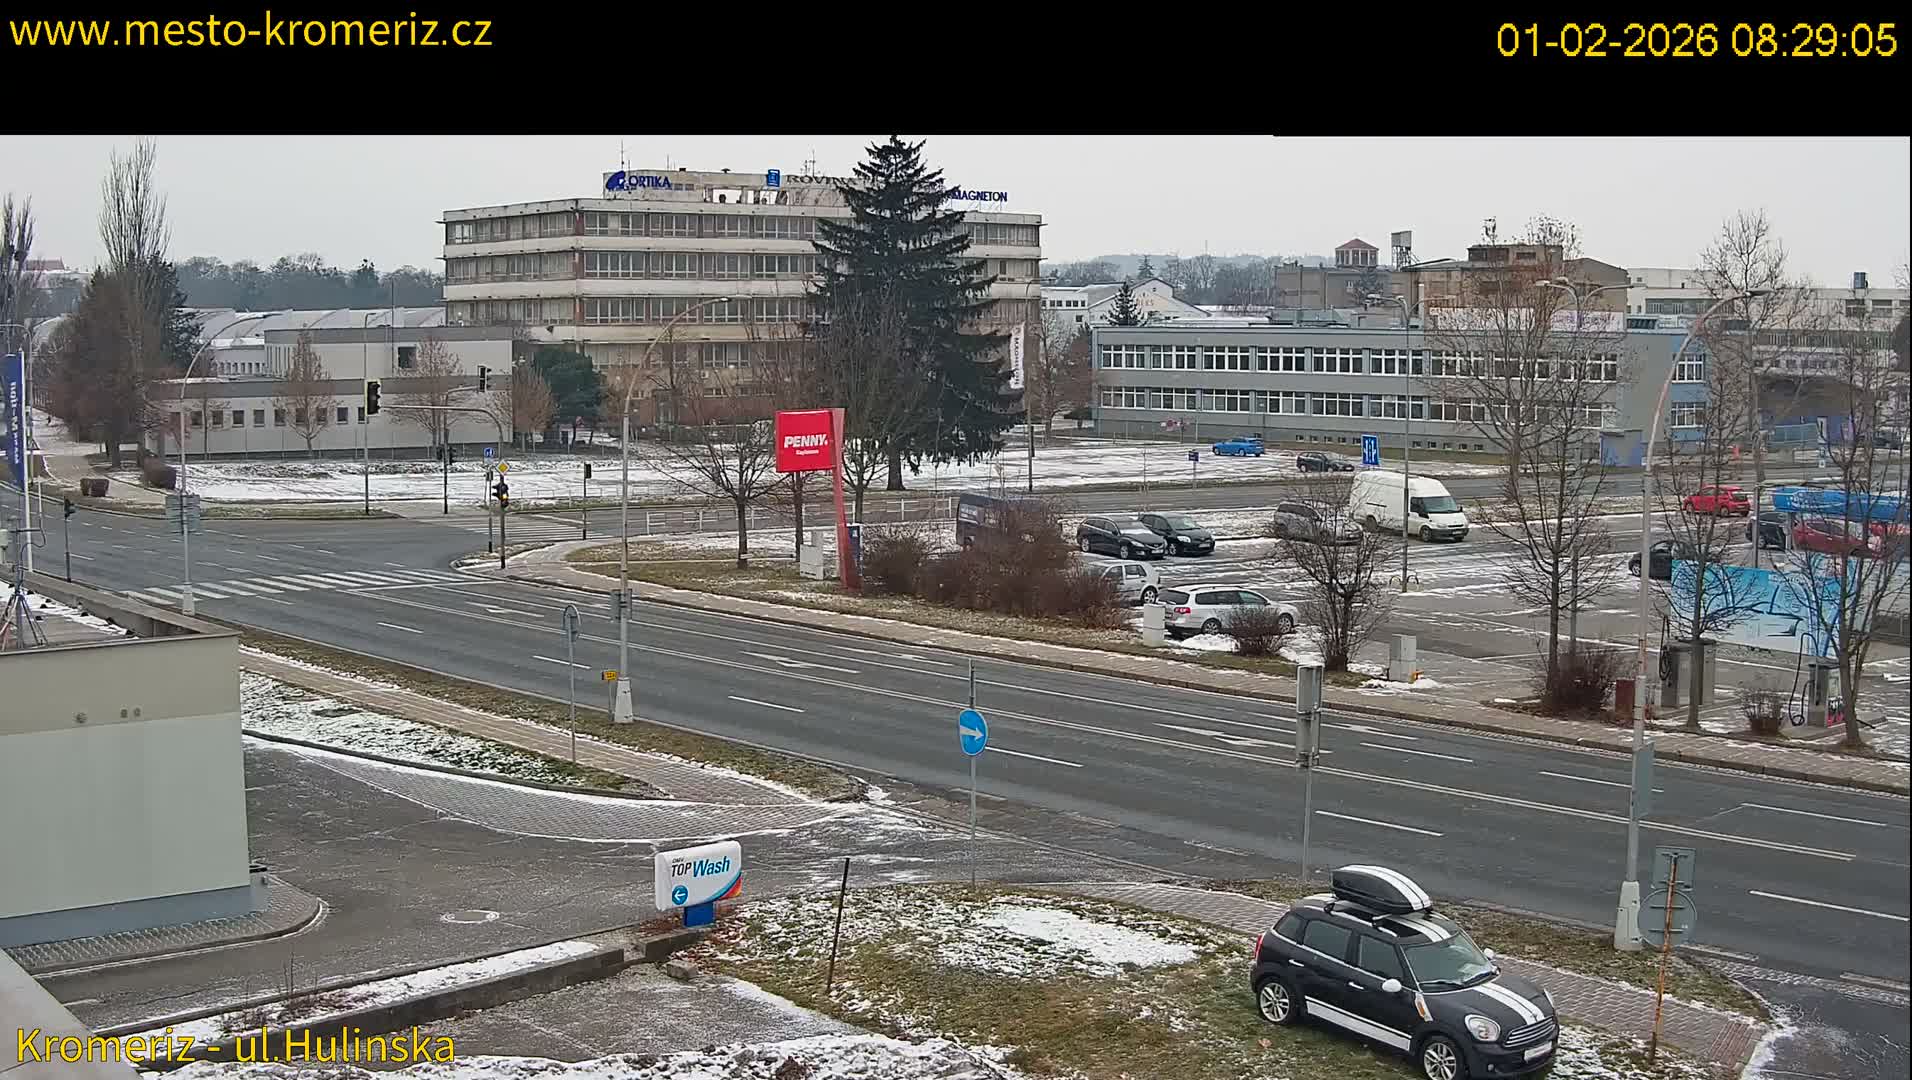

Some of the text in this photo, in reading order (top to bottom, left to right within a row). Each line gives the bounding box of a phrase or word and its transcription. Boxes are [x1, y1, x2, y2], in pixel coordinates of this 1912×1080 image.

[628, 175, 672, 188] ORTIKA
[951, 190, 1008, 202] MAGNETON
[671, 856, 730, 877] TOP Wash
